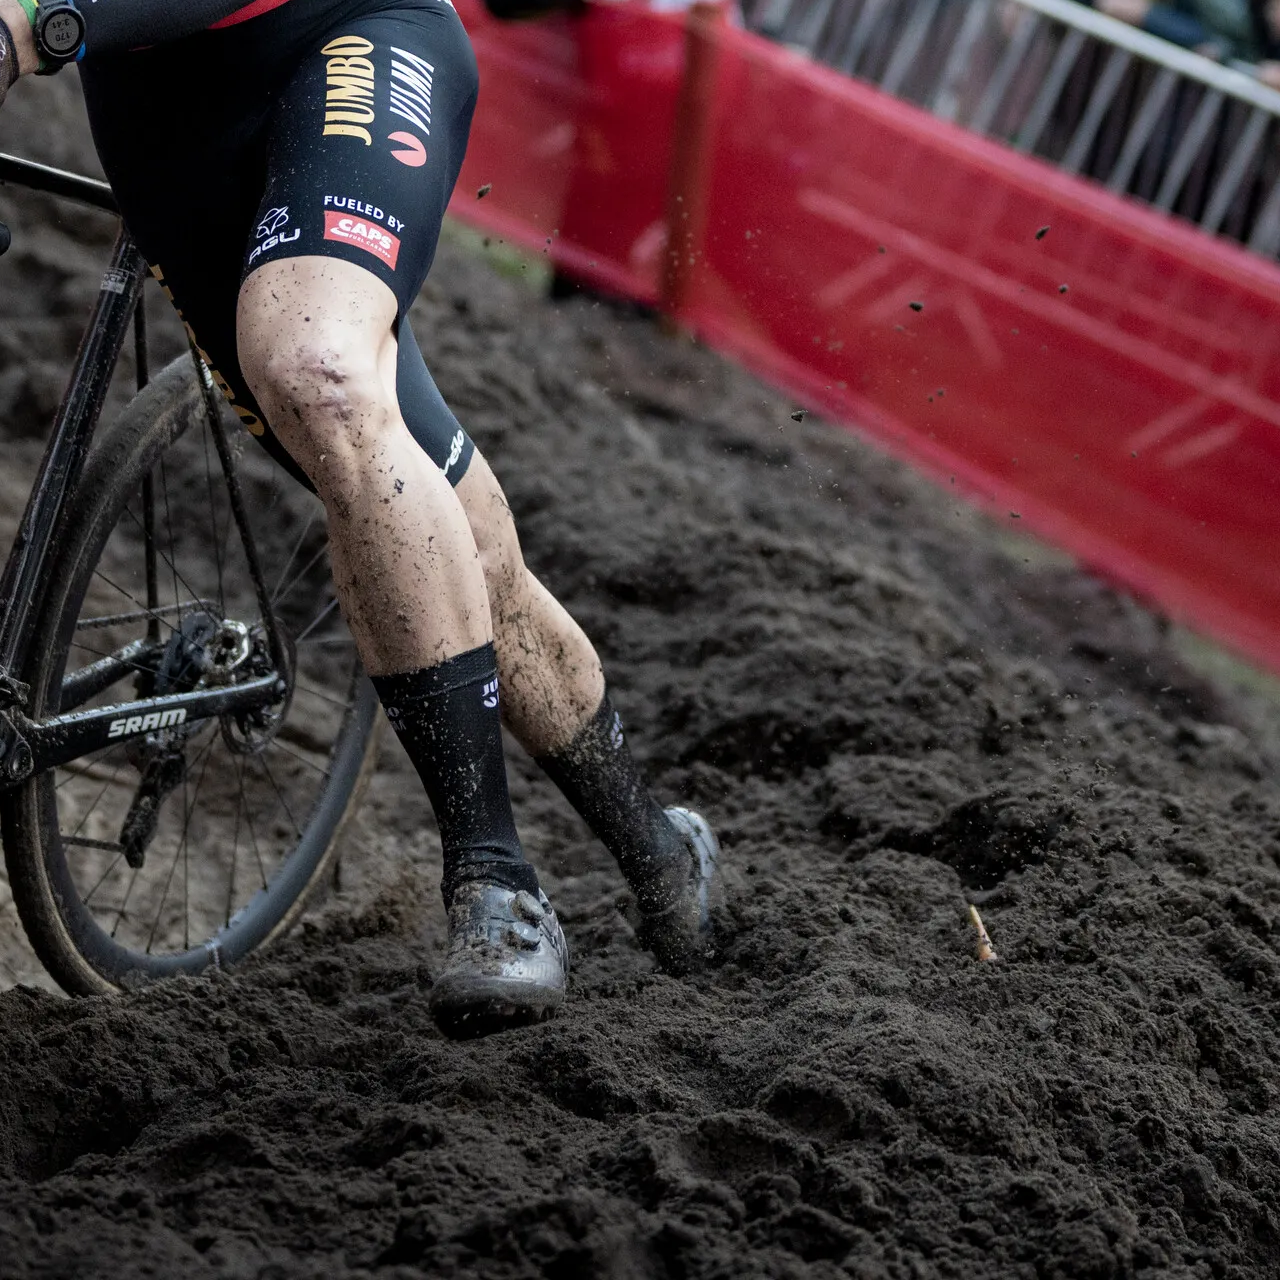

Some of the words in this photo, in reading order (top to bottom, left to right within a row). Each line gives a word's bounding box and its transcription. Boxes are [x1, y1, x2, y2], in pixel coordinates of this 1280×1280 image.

[320, 35, 375, 146] JUMBO
[389, 46, 435, 136] VISMA
[324, 195, 385, 220] FUELED
[387, 215, 405, 233] BY
[249, 228, 301, 265] AGU
[338, 218, 393, 250] CAPS
[349, 234, 365, 243] FUEL
[108, 708, 187, 738] SRAM
